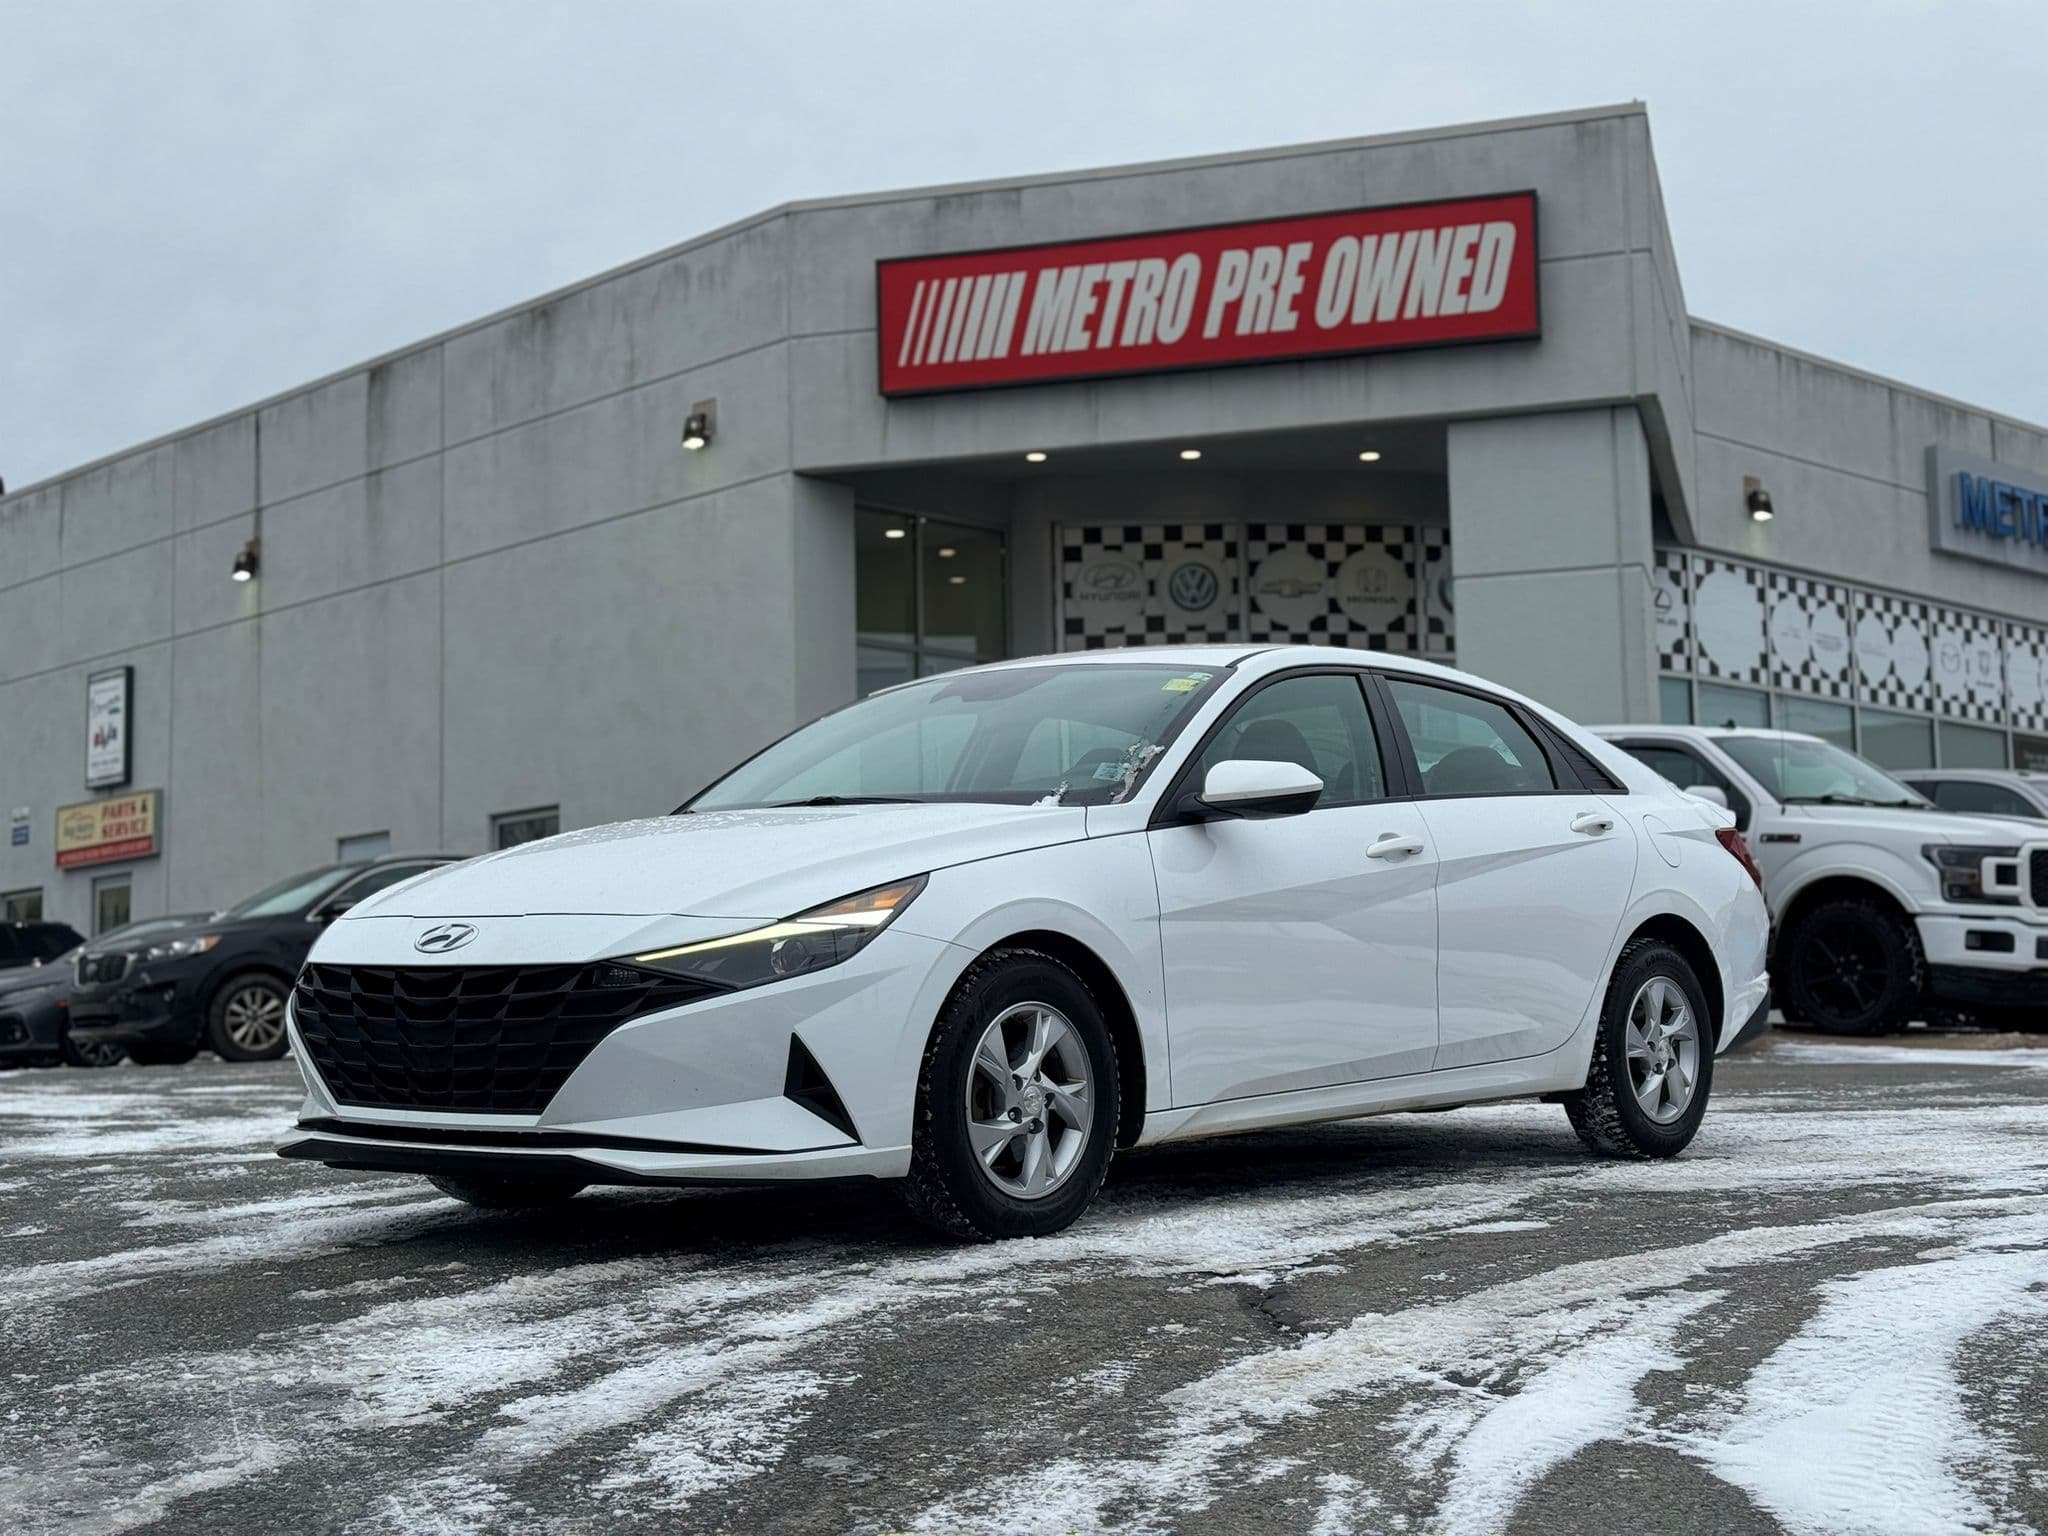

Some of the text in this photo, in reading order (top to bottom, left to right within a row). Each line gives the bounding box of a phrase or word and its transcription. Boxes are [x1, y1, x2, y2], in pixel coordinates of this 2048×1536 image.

[1020, 221, 1517, 356] METRO PRE OWNED
[101, 800, 136, 820] PARTS
[101, 817, 148, 840] SERVICE
